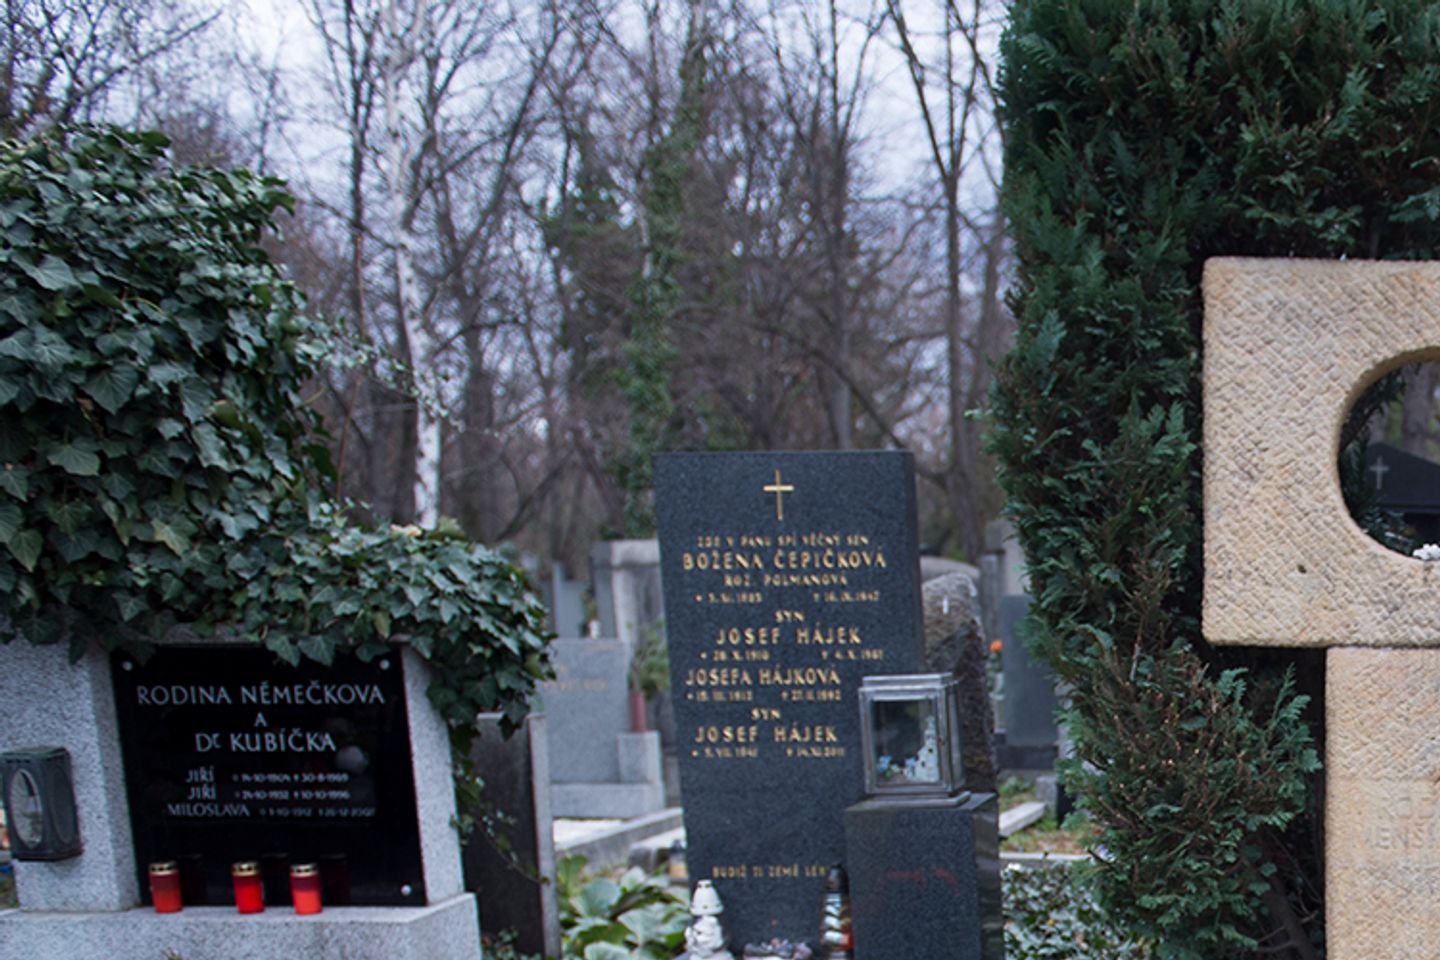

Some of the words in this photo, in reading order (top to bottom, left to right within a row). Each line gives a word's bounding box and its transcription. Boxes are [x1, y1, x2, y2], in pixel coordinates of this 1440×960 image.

[682, 549, 764, 570] BOŽENA
[773, 546, 887, 569] ČEPIČKOVÁ
[774, 610, 804, 623] SYN
[716, 627, 781, 645] JOSEF
[796, 622, 862, 645] HÁJEK
[686, 667, 752, 686] JOSEFA
[759, 663, 841, 686] HÁJKOVÁ
[136, 685, 232, 705] RODINA
[240, 680, 385, 705] NĚMEČKOVA
[253, 712, 268, 727] A
[751, 707, 781, 720] SYN
[229, 728, 337, 753] KUBÍČKA
[694, 725, 758, 743] JOSEF
[773, 721, 838, 743] HÁJEK
[185, 764, 215, 783] JIŘÍ
[186, 783, 217, 800] JIŘÍ
[167, 802, 250, 817] MILOSLAVA
